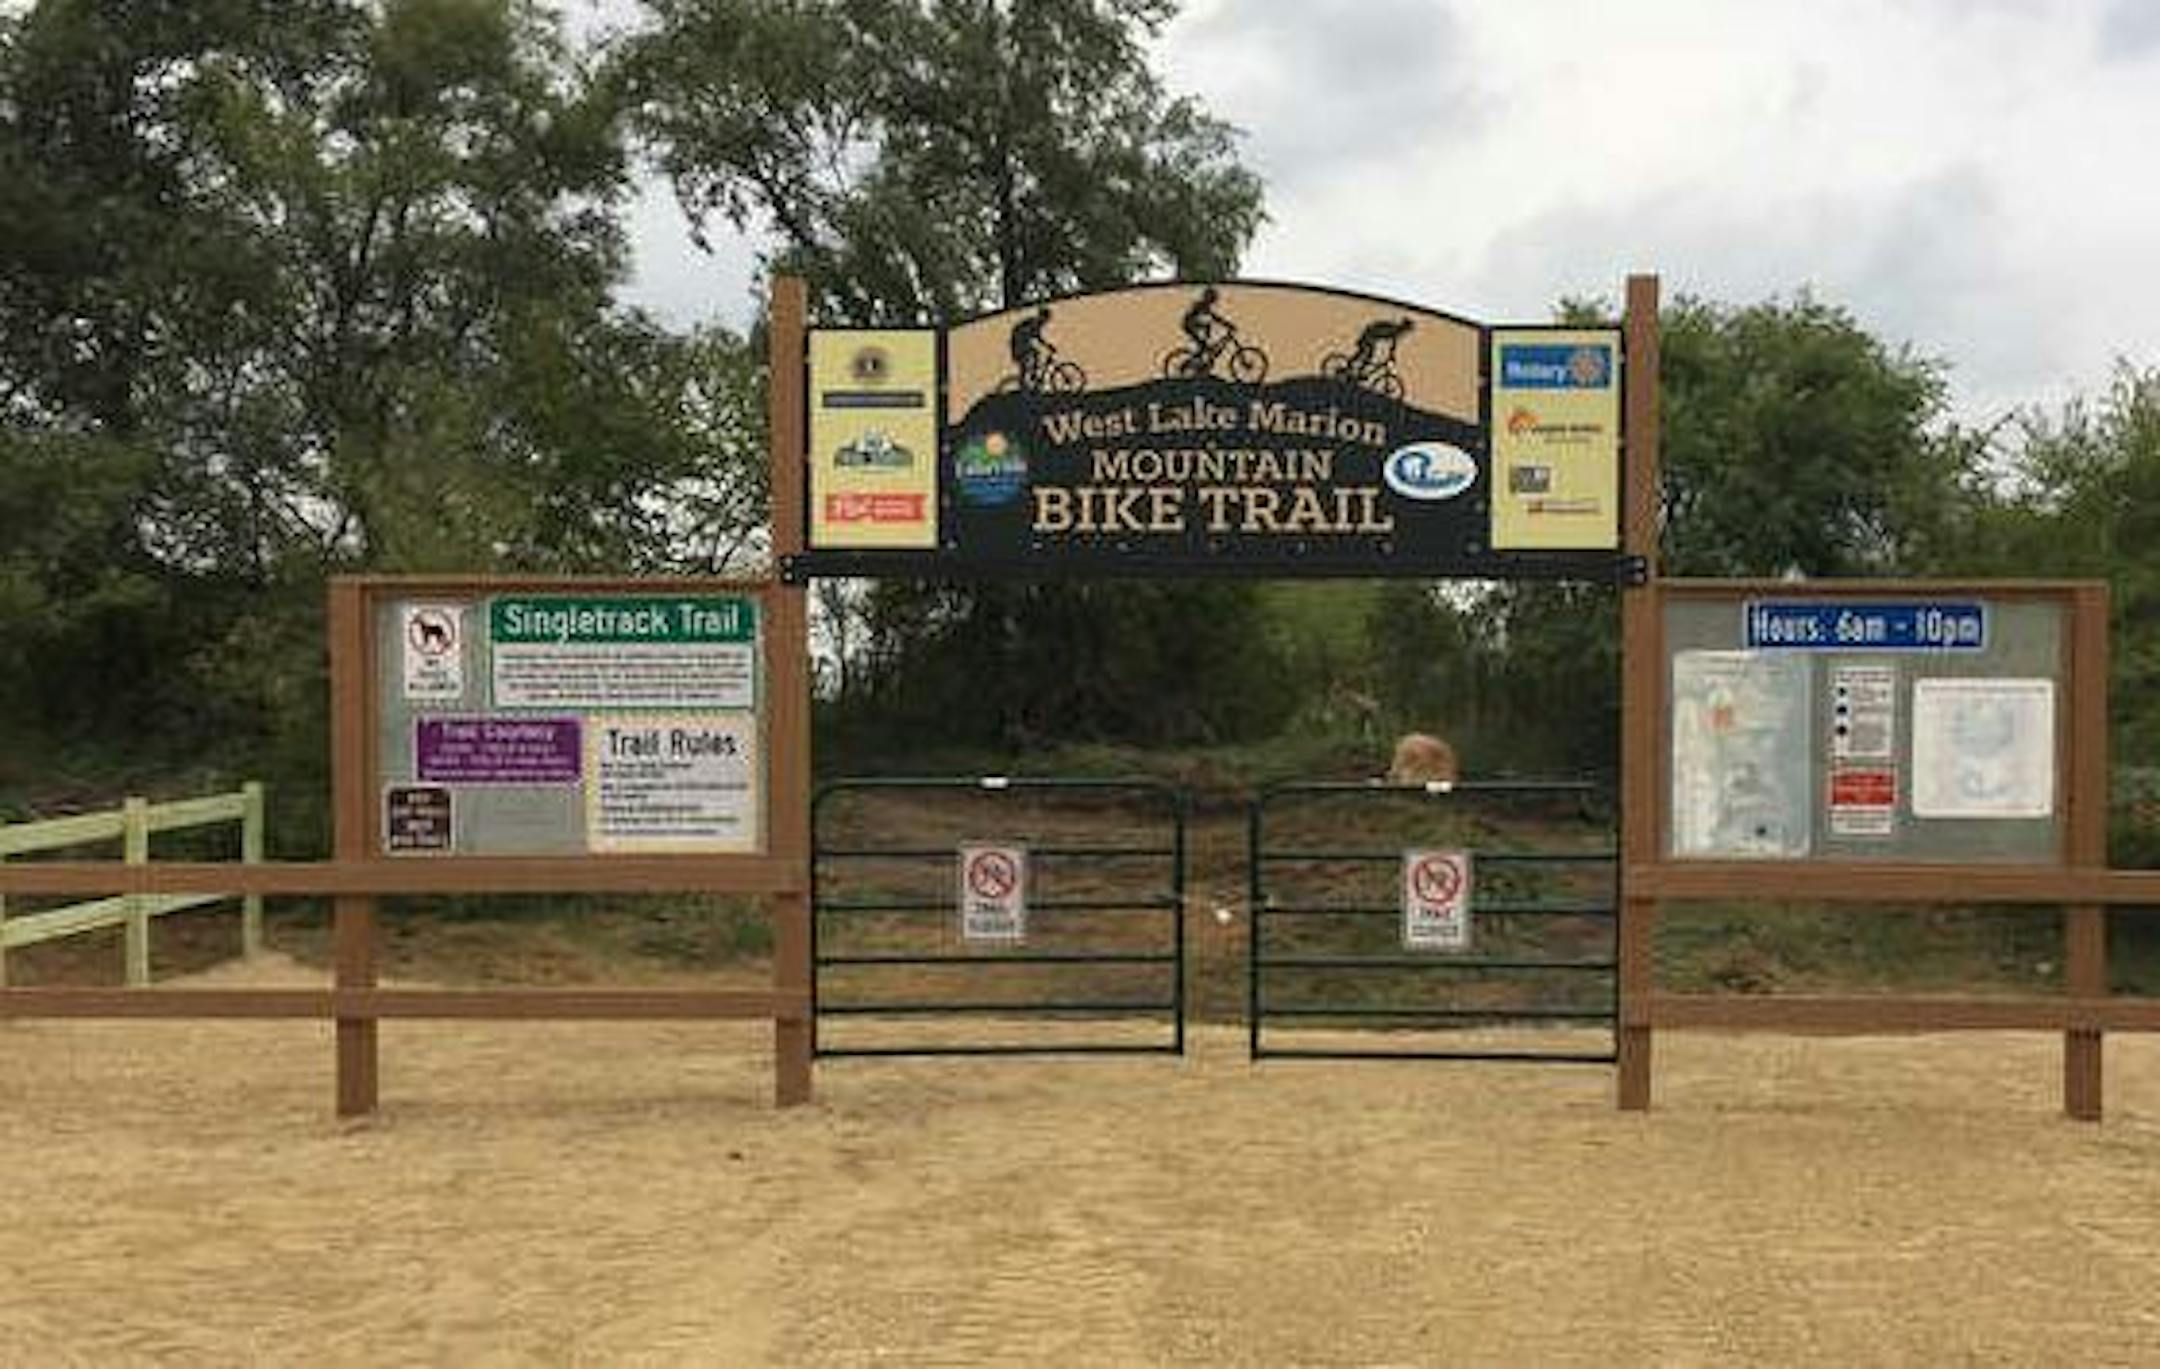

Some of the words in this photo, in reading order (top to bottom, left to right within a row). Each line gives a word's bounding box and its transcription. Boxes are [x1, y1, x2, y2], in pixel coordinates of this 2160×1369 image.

[1043, 408, 1138, 446] West
[1147, 396, 1238, 434] Lake
[1247, 401, 1387, 446] Marion
[1092, 447, 1334, 482] MOUNTAIN
[1031, 486, 1187, 532] BIKE
[1198, 486, 1395, 532] TRAIL
[503, 603, 669, 644] Singletrack
[677, 603, 741, 637] Trail
[1752, 607, 1828, 643] Hours:
[1835, 609, 1887, 643] 6am
[1914, 607, 1982, 646] 10pm
[608, 727, 660, 757] Trail
[671, 727, 738, 757] Rules
